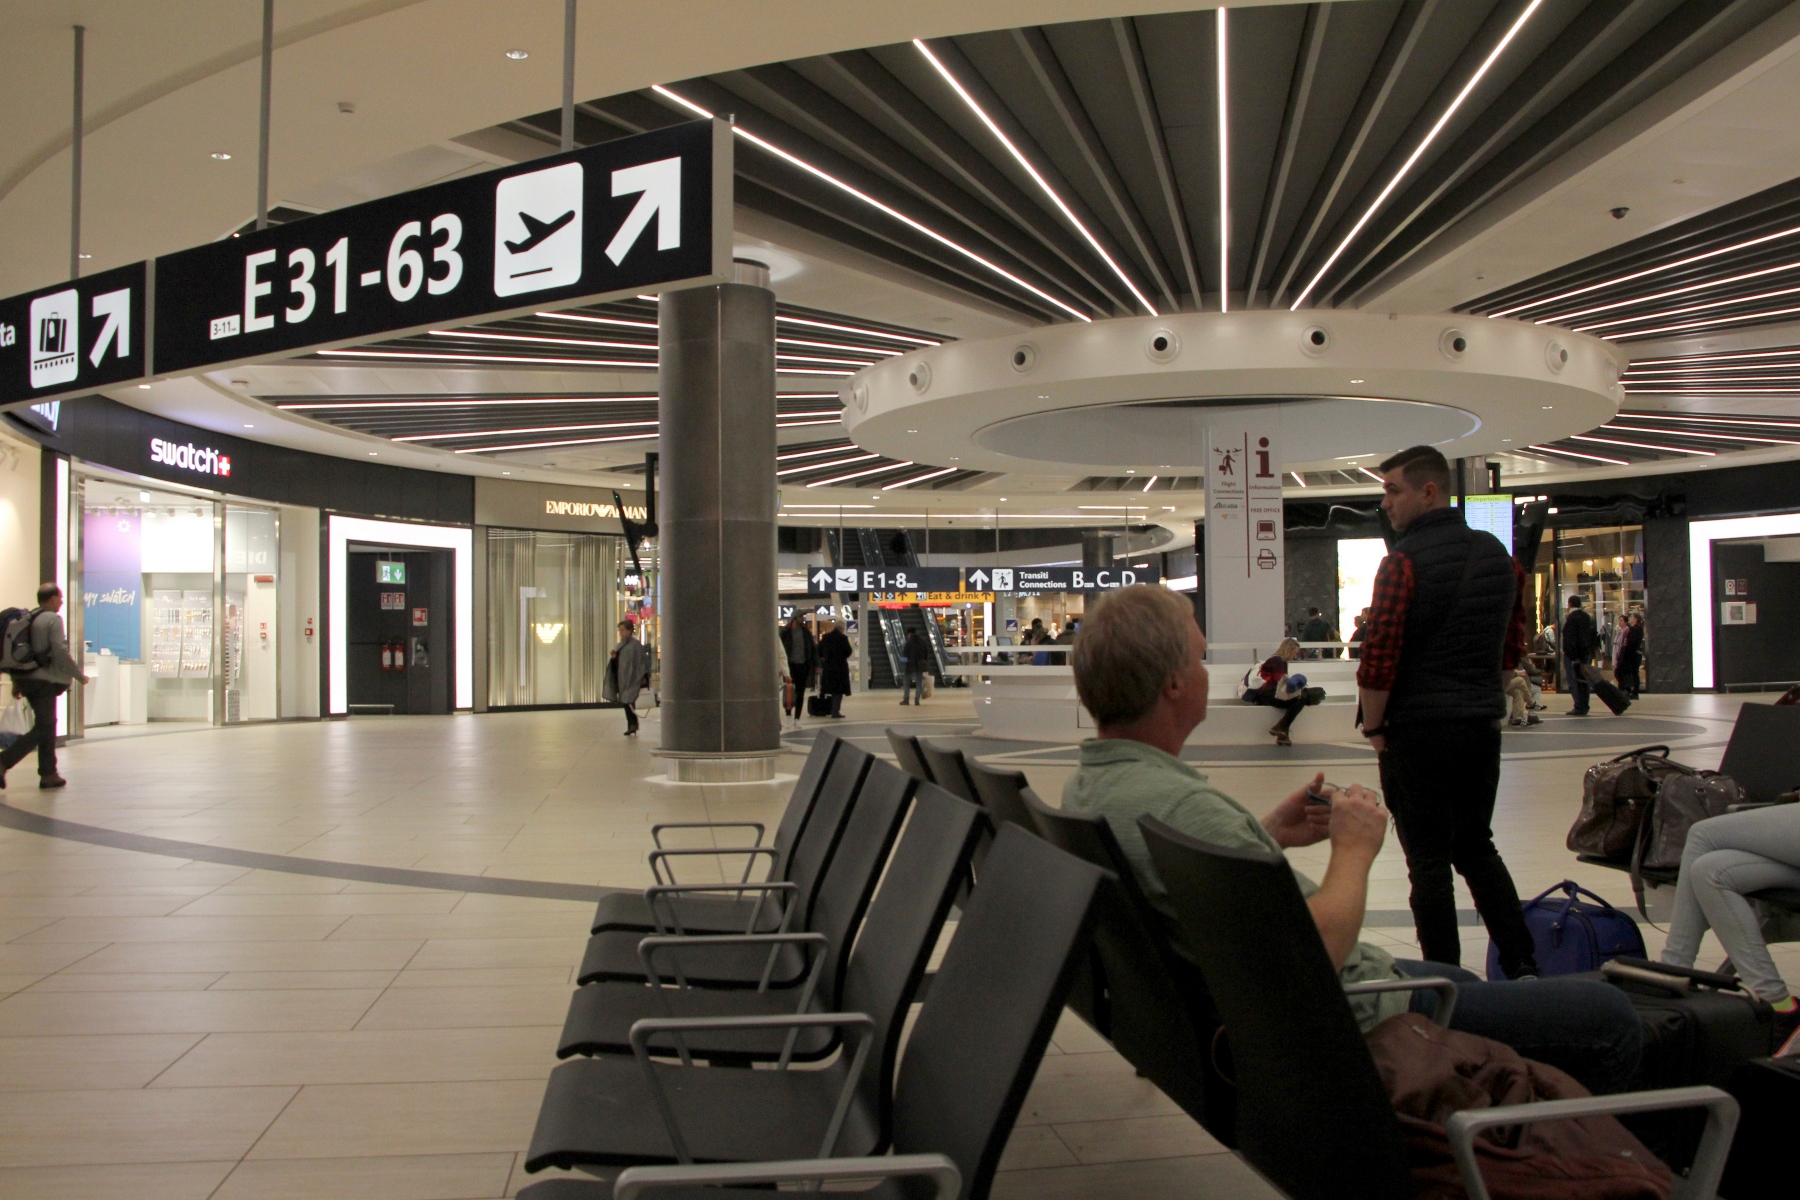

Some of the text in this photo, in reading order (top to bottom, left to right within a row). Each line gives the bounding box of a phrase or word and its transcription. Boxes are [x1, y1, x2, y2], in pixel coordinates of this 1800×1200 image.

[244, 212, 463, 334] E31-63
[150, 437, 219, 475] swatch
[546, 501, 594, 516] EMPORIO
[1019, 571, 1049, 579] Transiti
[1019, 580, 1067, 588] Connections
[928, 592, 979, 600] Eat & drink
